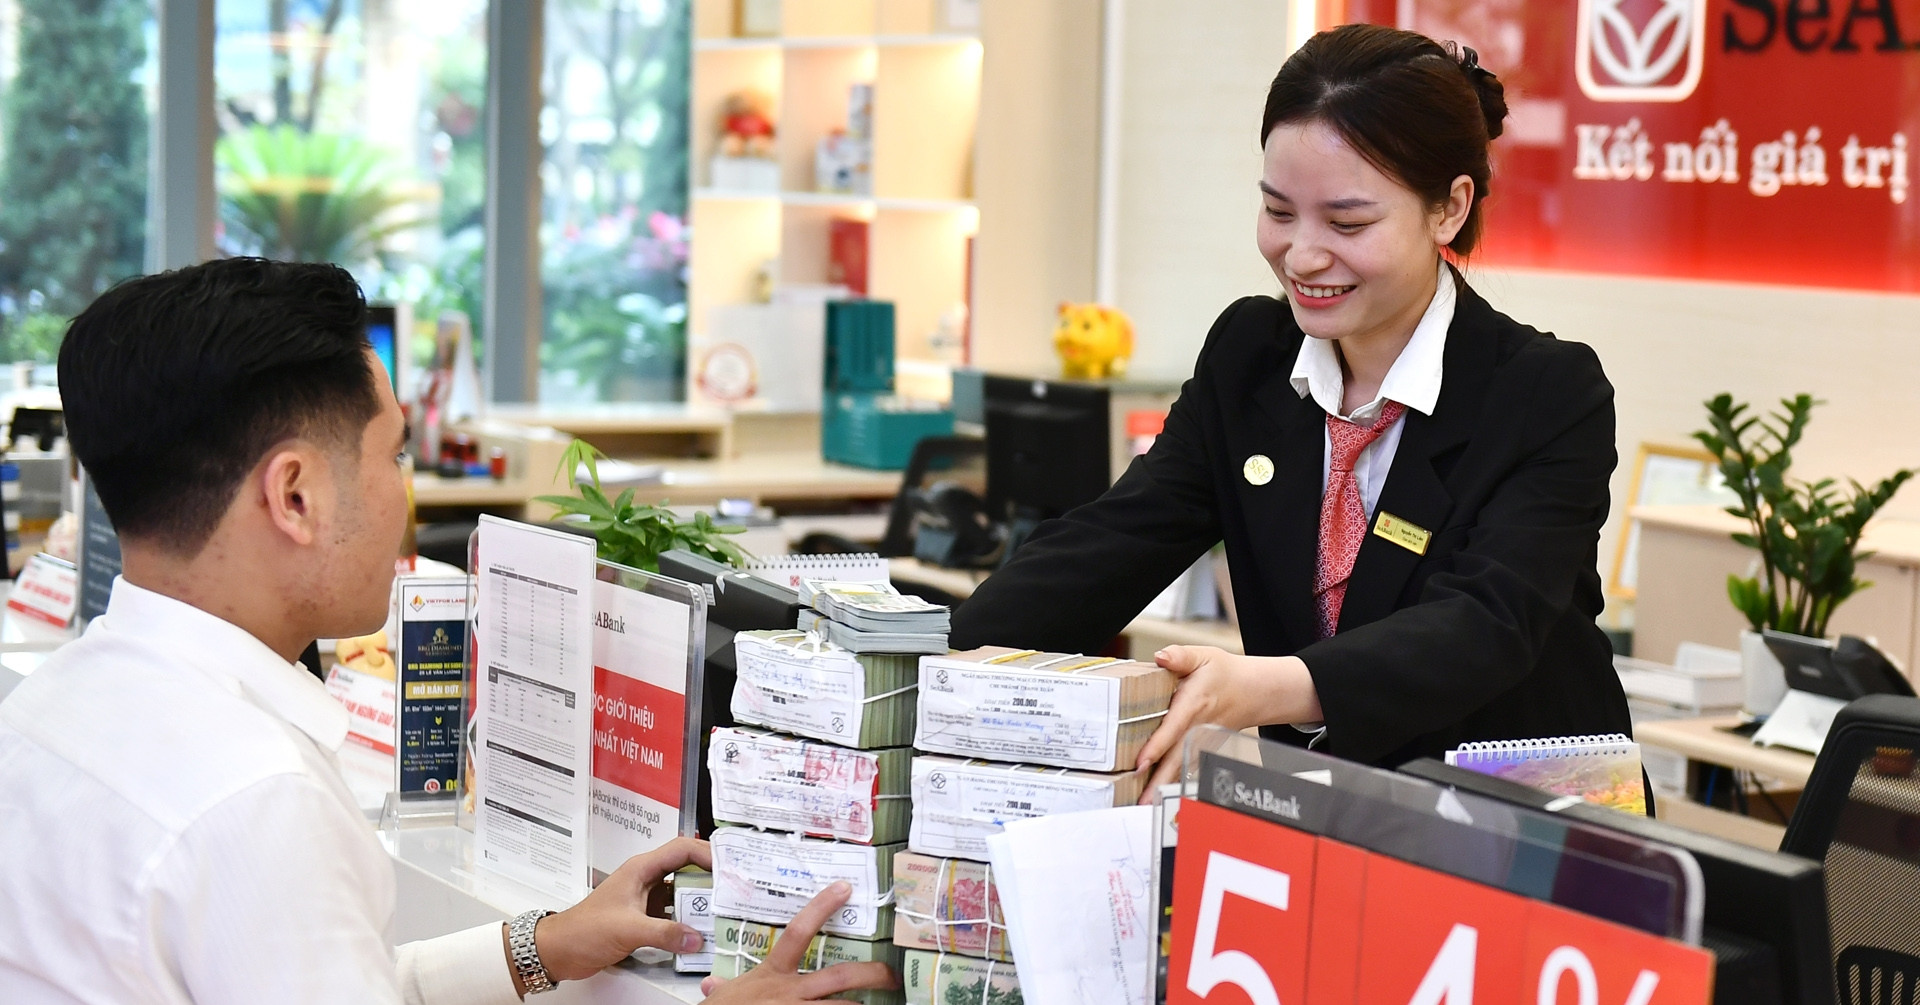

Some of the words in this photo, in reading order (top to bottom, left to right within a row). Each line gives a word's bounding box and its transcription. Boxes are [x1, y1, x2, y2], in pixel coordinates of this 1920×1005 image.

[1722, 0, 1920, 53] SeA
[1573, 117, 1655, 181] Kết
[1748, 126, 1830, 198] giá
[1840, 133, 1909, 205] trị
[594, 610, 626, 634] ABank
[427, 683, 443, 695] BÁN
[1012, 697, 1038, 708] 200.000
[606, 697, 628, 720] GIỚI
[629, 705, 655, 733] THIỆU
[594, 727, 619, 754] NHẤT
[620, 737, 640, 764] VIỆT
[641, 746, 664, 770] NAM
[1006, 800, 1032, 811] 200.000
[1233, 781, 1302, 820] SeABank
